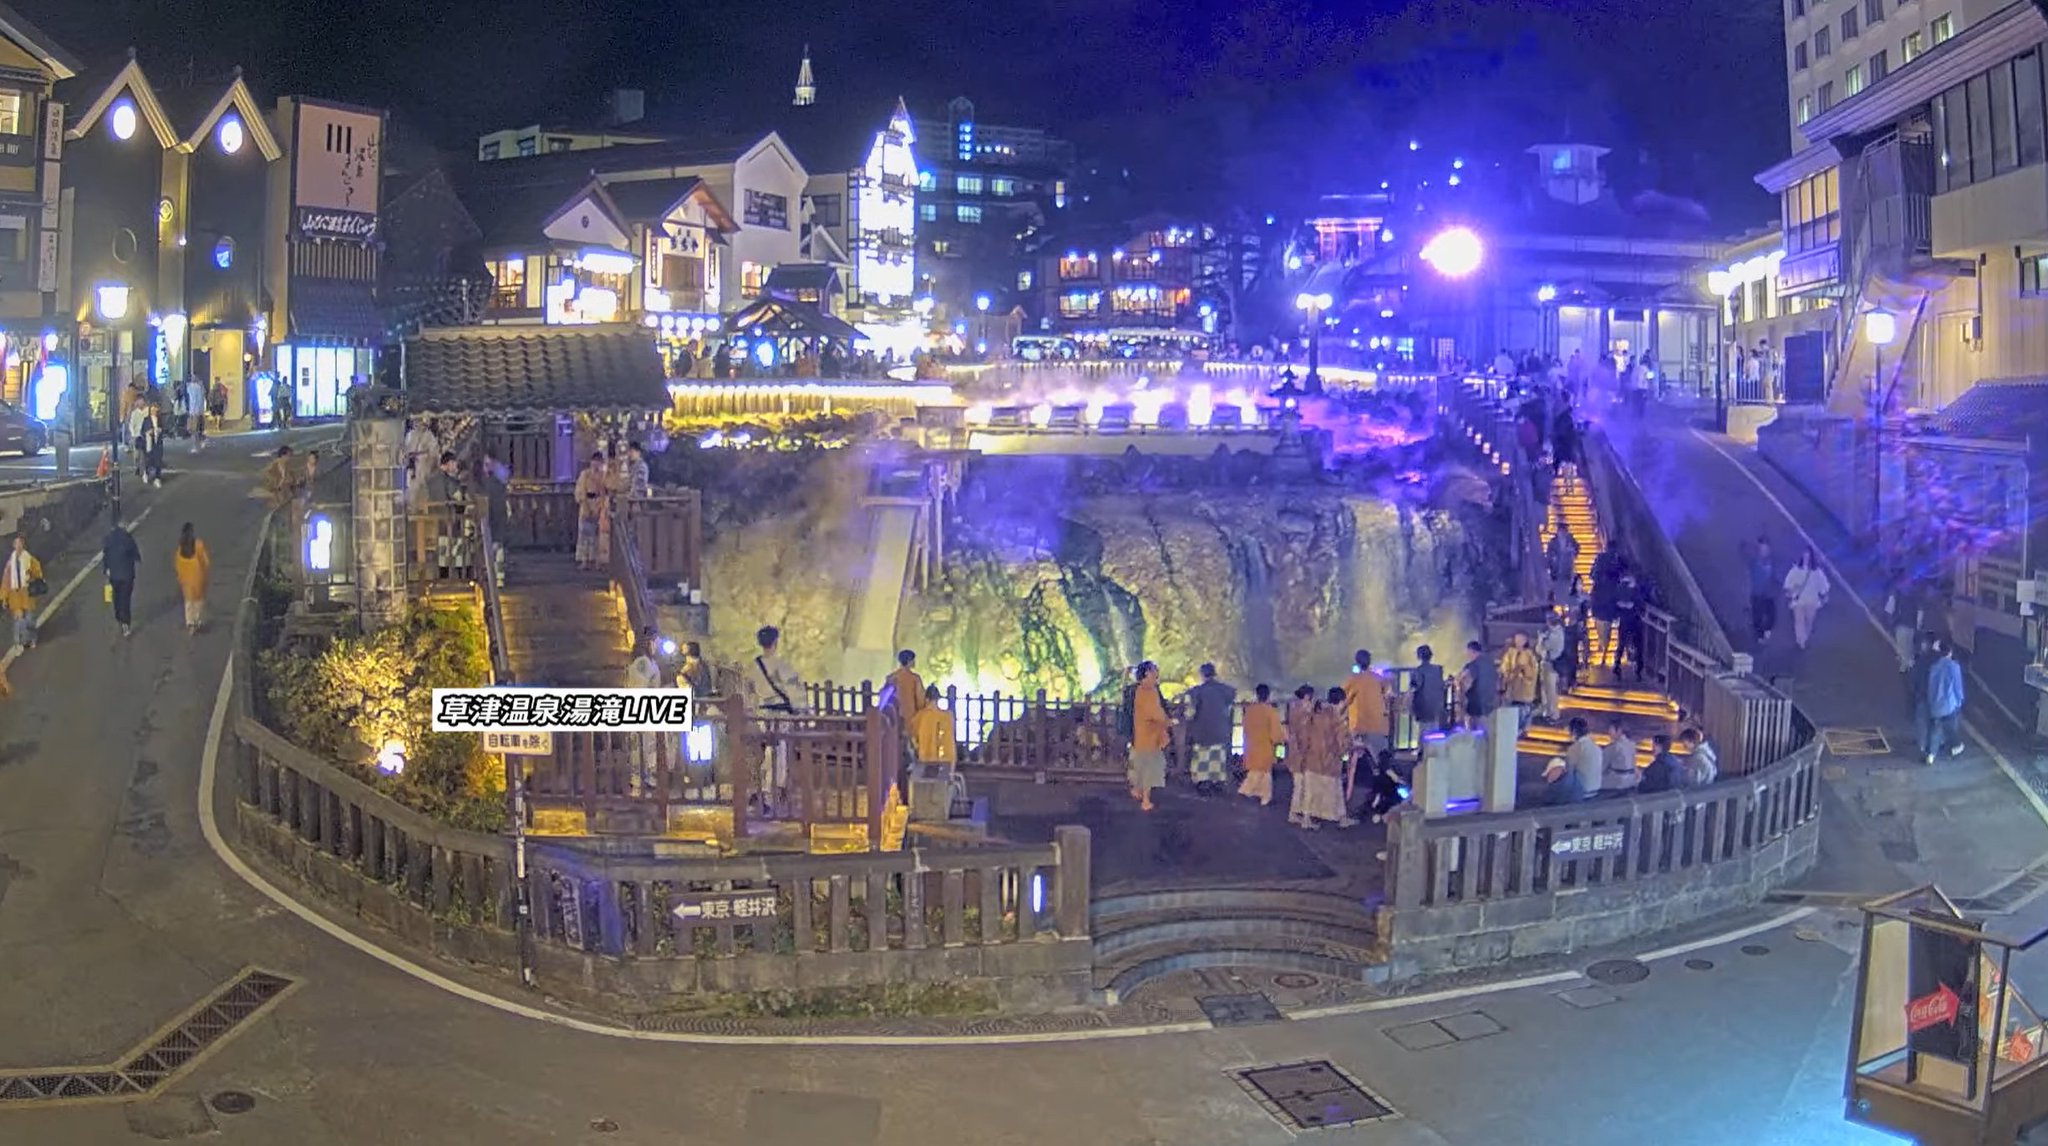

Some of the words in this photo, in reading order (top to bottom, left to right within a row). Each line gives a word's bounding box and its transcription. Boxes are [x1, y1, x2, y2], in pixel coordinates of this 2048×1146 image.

[488, 733, 549, 749] 自転車を除く
[701, 900, 730, 920] 東京
[733, 897, 777, 917] 軽井沢
